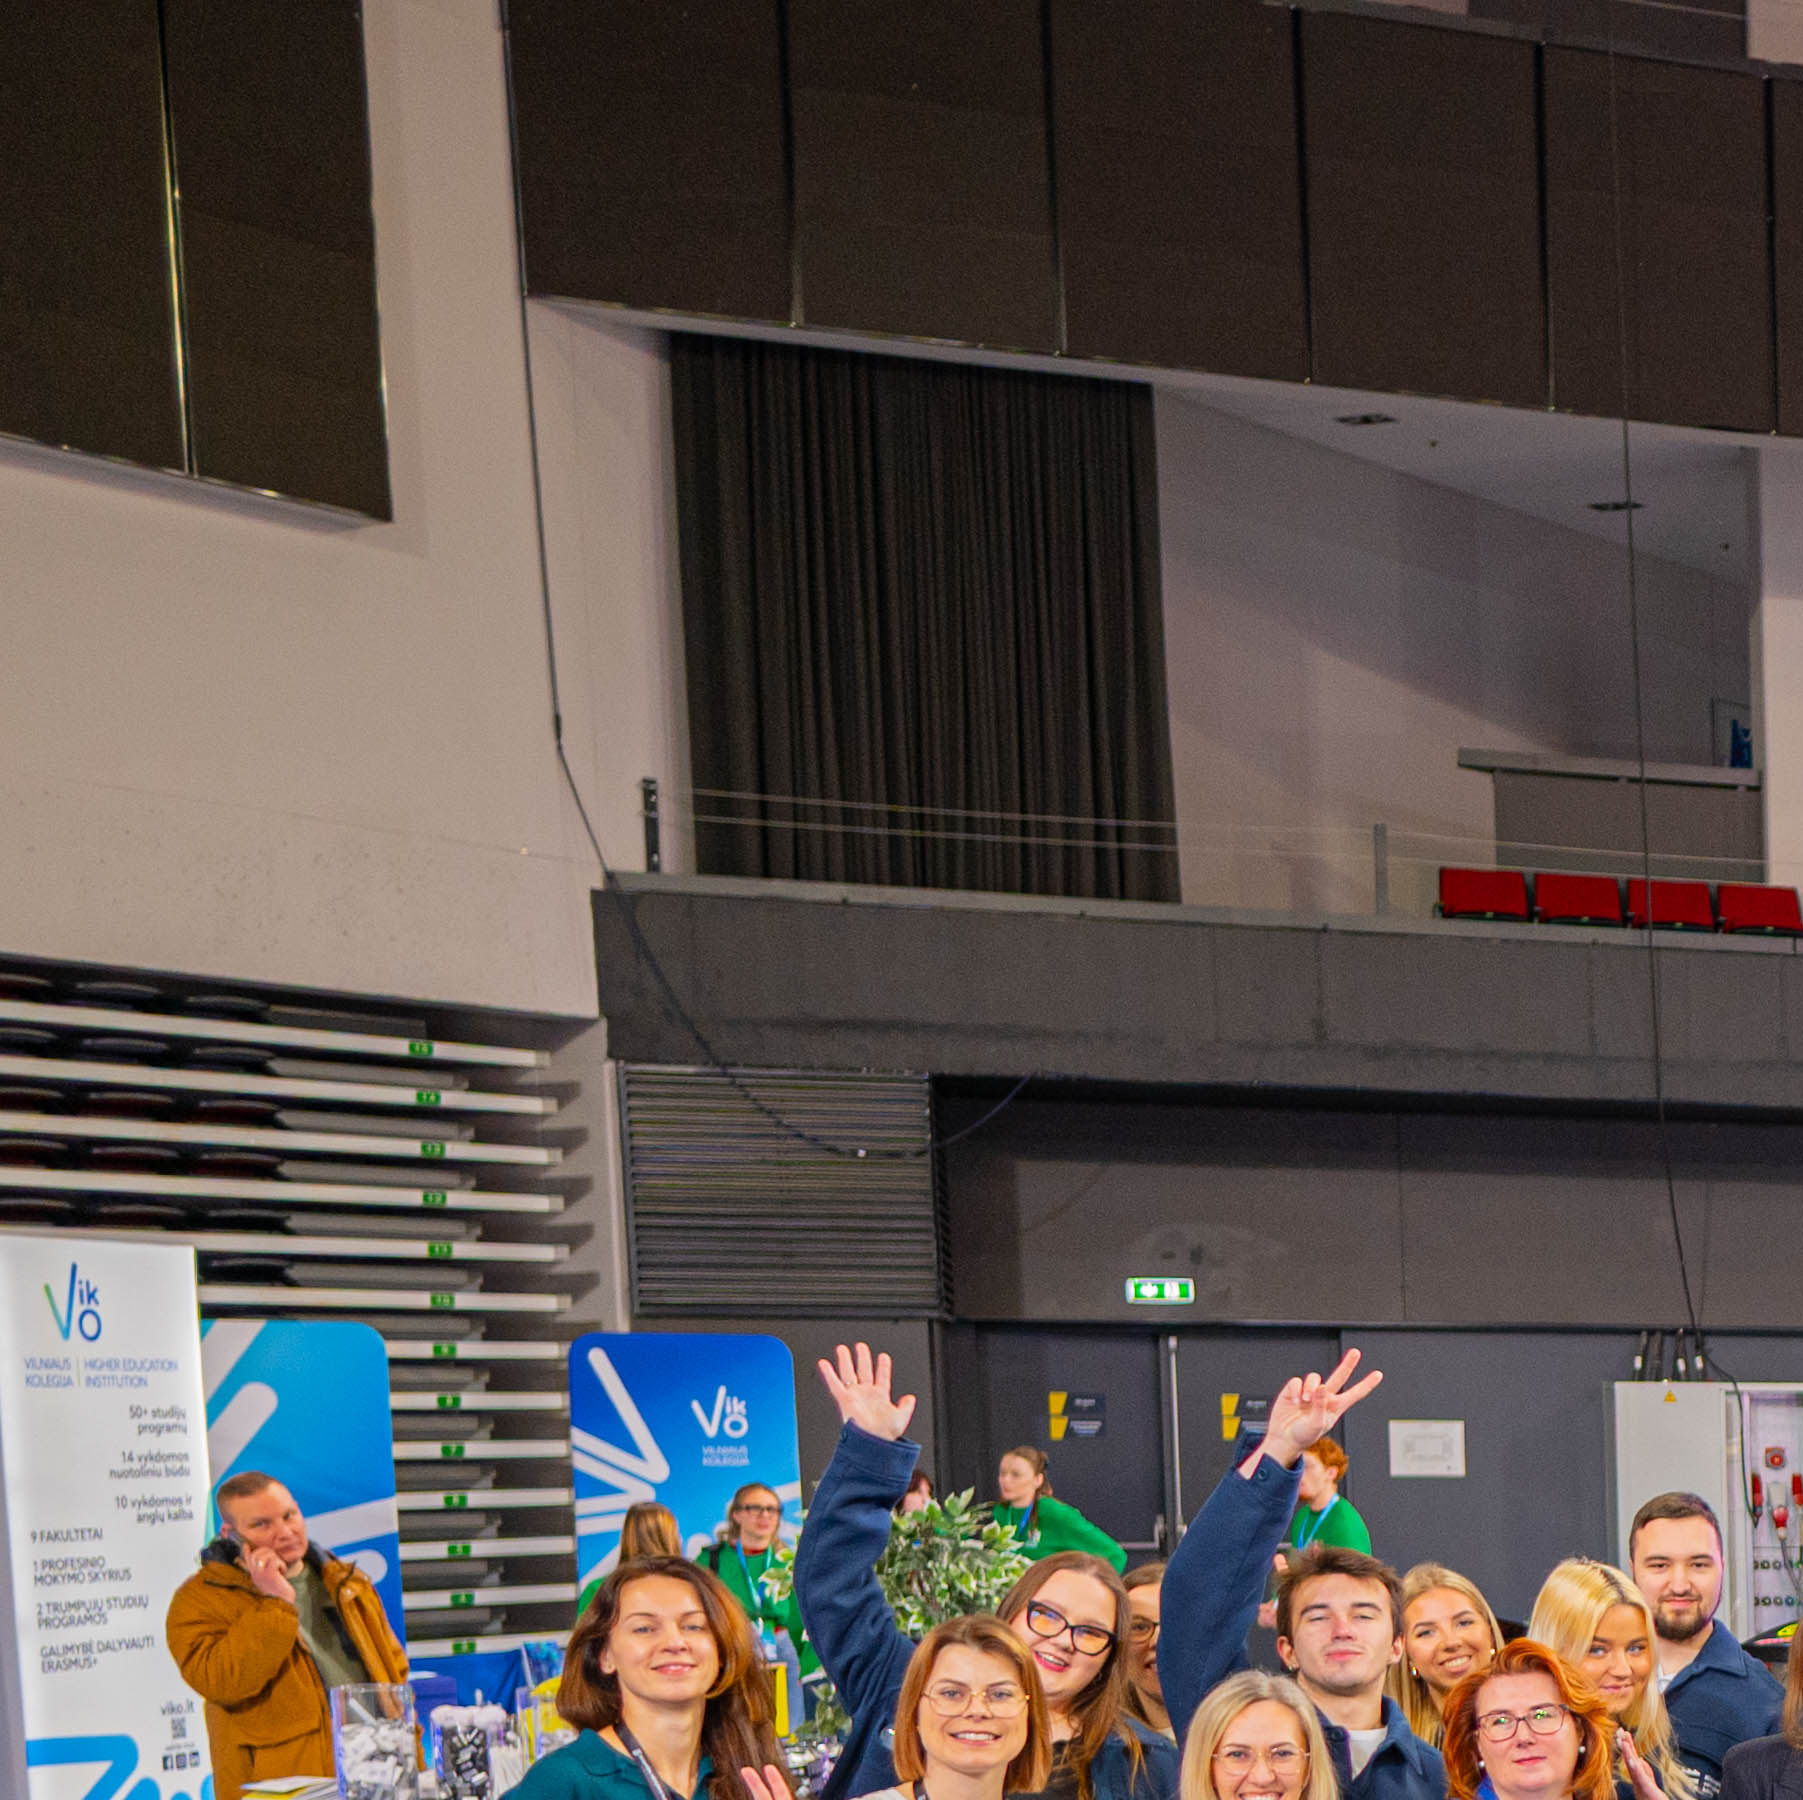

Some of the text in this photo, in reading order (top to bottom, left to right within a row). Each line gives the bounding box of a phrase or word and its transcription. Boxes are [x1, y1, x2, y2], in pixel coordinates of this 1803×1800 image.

[39, 1528, 104, 1543] FAKULTETAI
[41, 1556, 106, 1573] PROFESINIO
[37, 1612, 108, 1630] PROGRAMOS
[97, 1636, 155, 1654] DALYVAUTI
[161, 1699, 196, 1715] viko.lt
